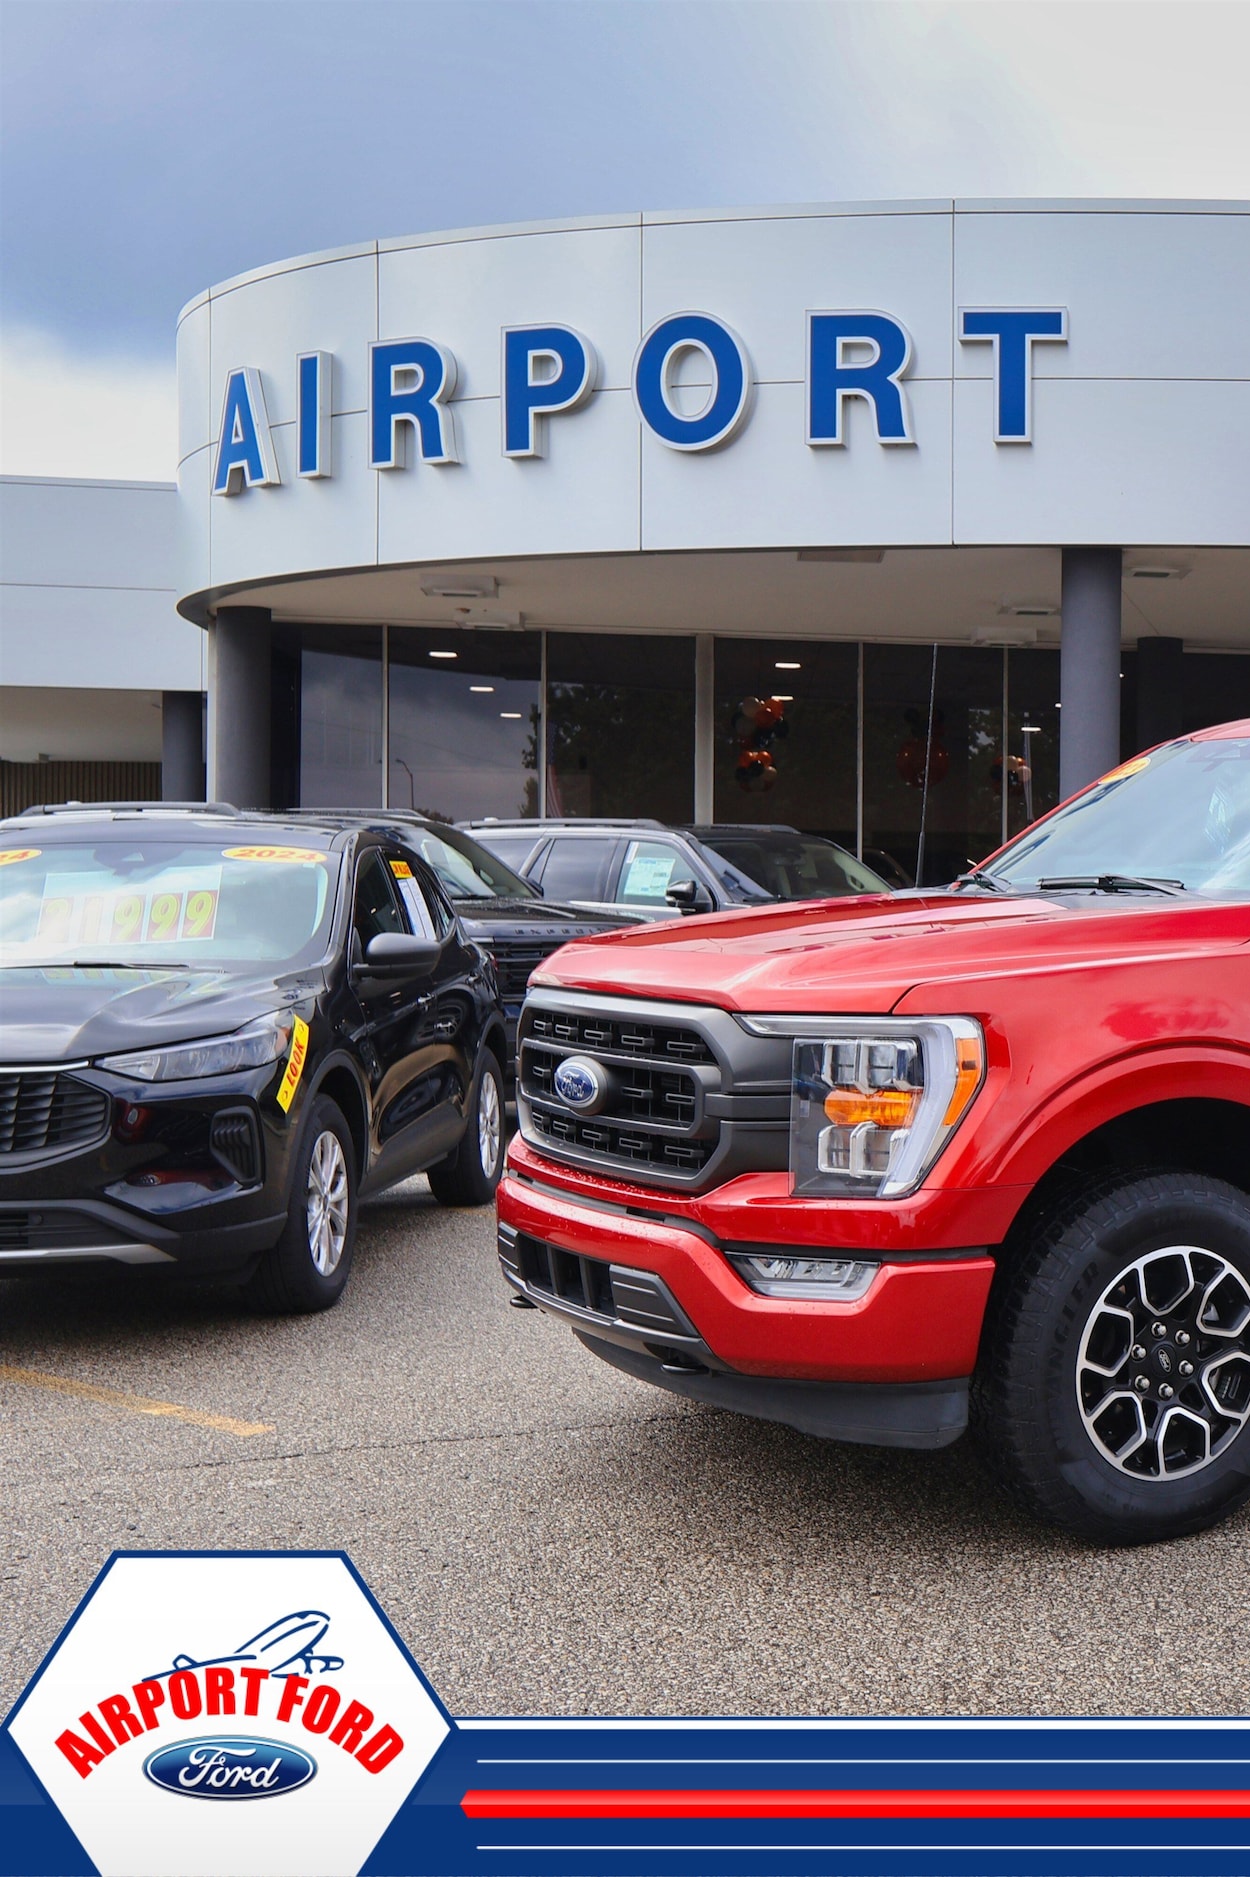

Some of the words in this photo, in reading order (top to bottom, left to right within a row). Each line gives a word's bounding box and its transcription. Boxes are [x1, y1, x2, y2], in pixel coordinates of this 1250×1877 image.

[212, 306, 1068, 497] AIRPORT
[233, 849, 318, 860] 2024
[286, 1036, 305, 1087] LOOK
[561, 1070, 585, 1099] Ford
